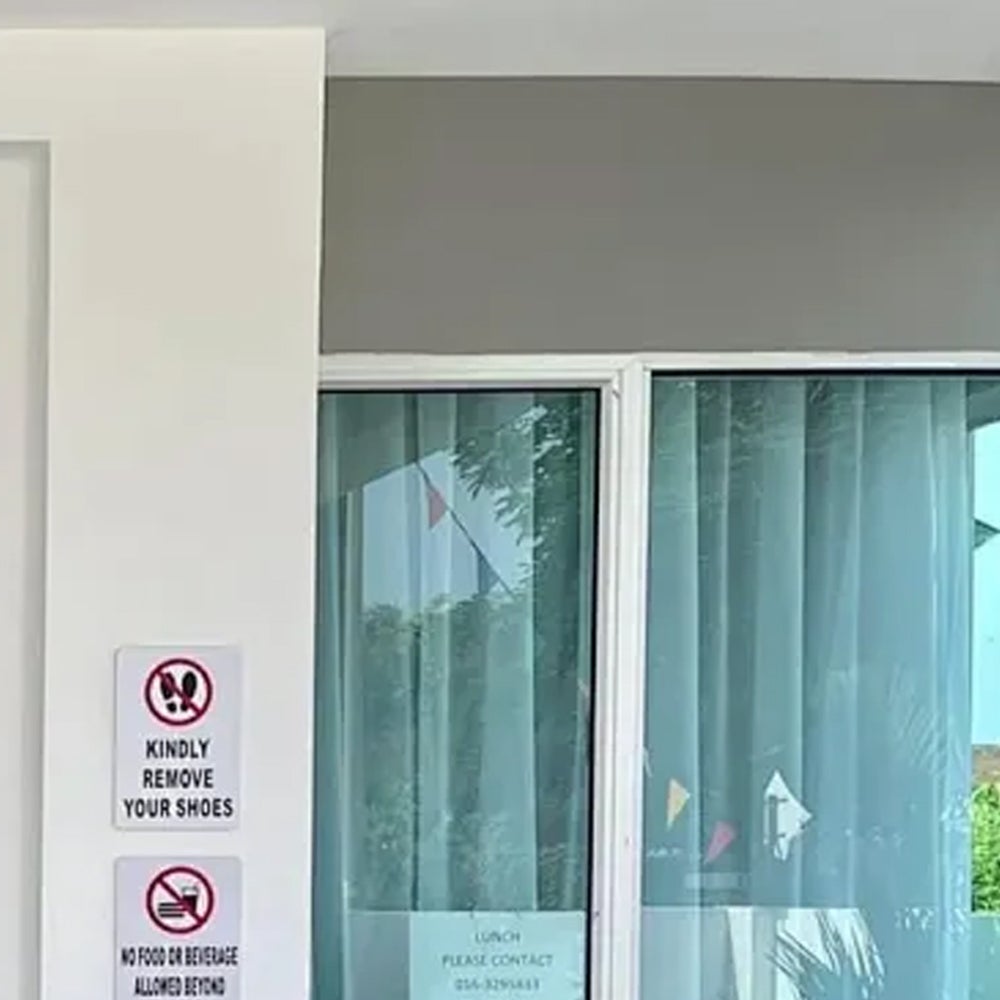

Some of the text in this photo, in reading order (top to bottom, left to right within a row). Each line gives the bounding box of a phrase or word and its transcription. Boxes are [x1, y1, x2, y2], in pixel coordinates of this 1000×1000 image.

[145, 738, 210, 759] KINDLY
[143, 767, 214, 789] REMOVE
[124, 798, 233, 818] YOUR SHOES
[475, 931, 521, 944] LUNCH
[121, 946, 238, 967] NO FOOD OR BEVERAGE
[442, 954, 553, 968] PLEASE CONTACT
[134, 976, 225, 996] ALLOWED BEYOND
